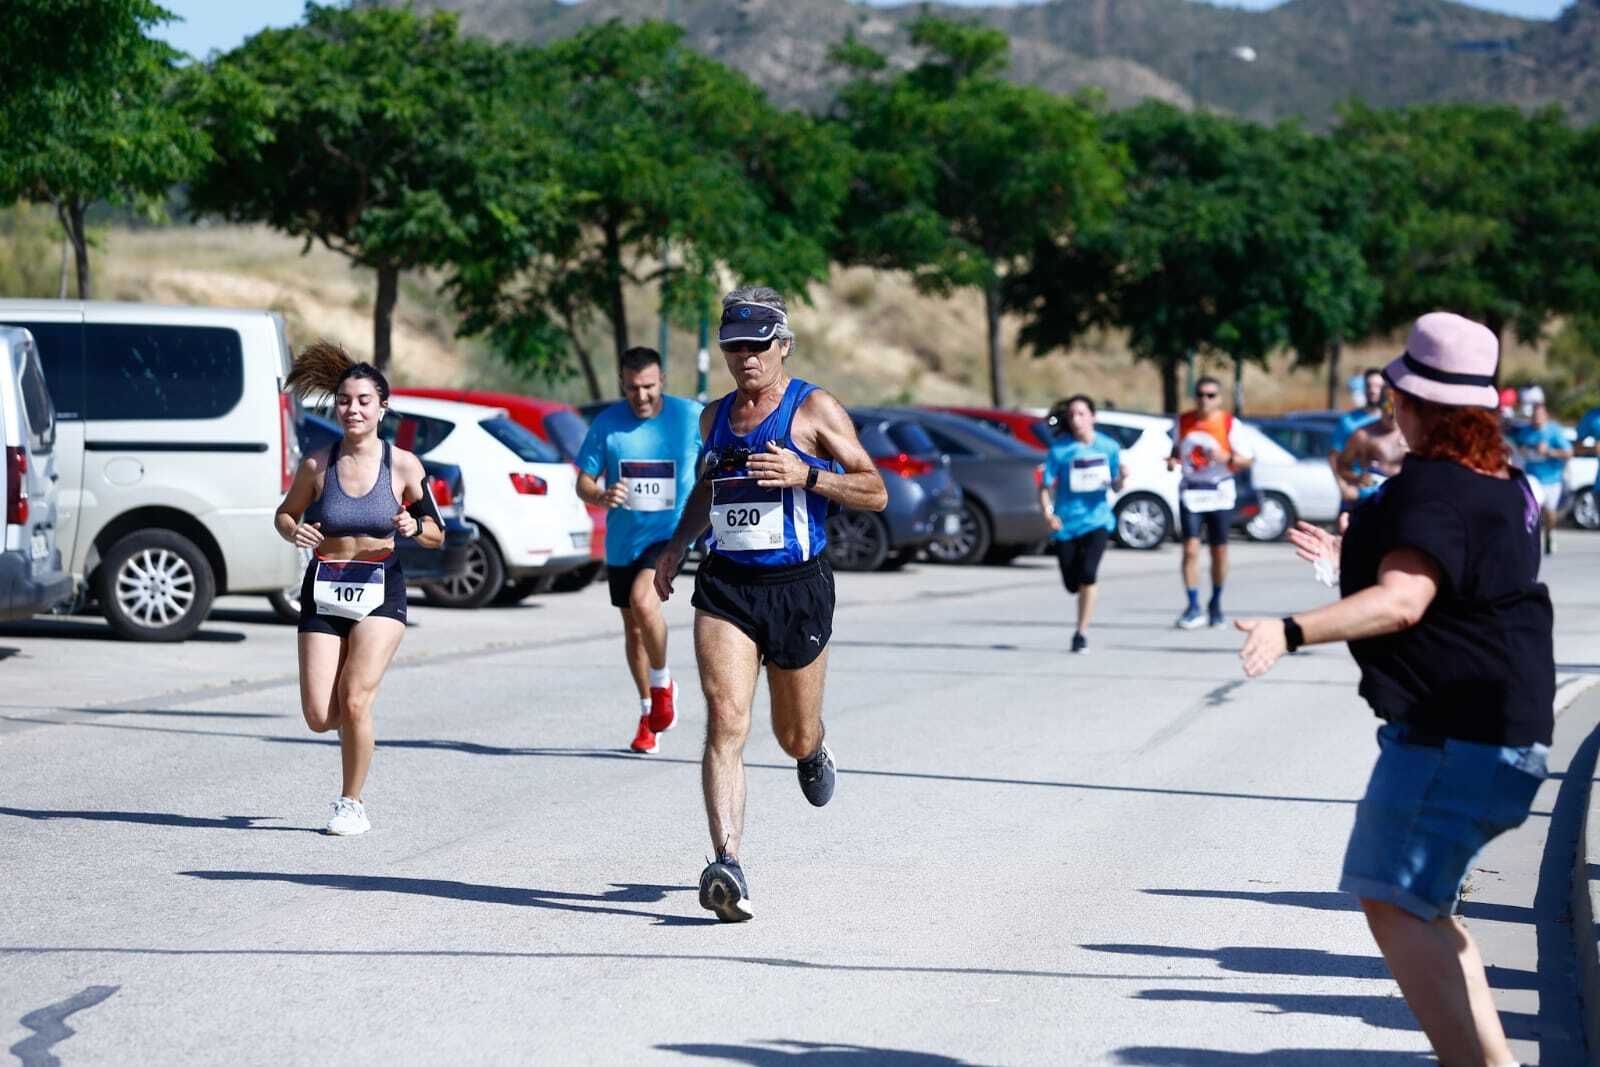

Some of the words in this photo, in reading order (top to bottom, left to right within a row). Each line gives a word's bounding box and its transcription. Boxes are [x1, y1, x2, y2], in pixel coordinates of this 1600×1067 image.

[634, 482, 660, 495] 410
[726, 508, 760, 527] 620
[334, 586, 365, 602] 107
